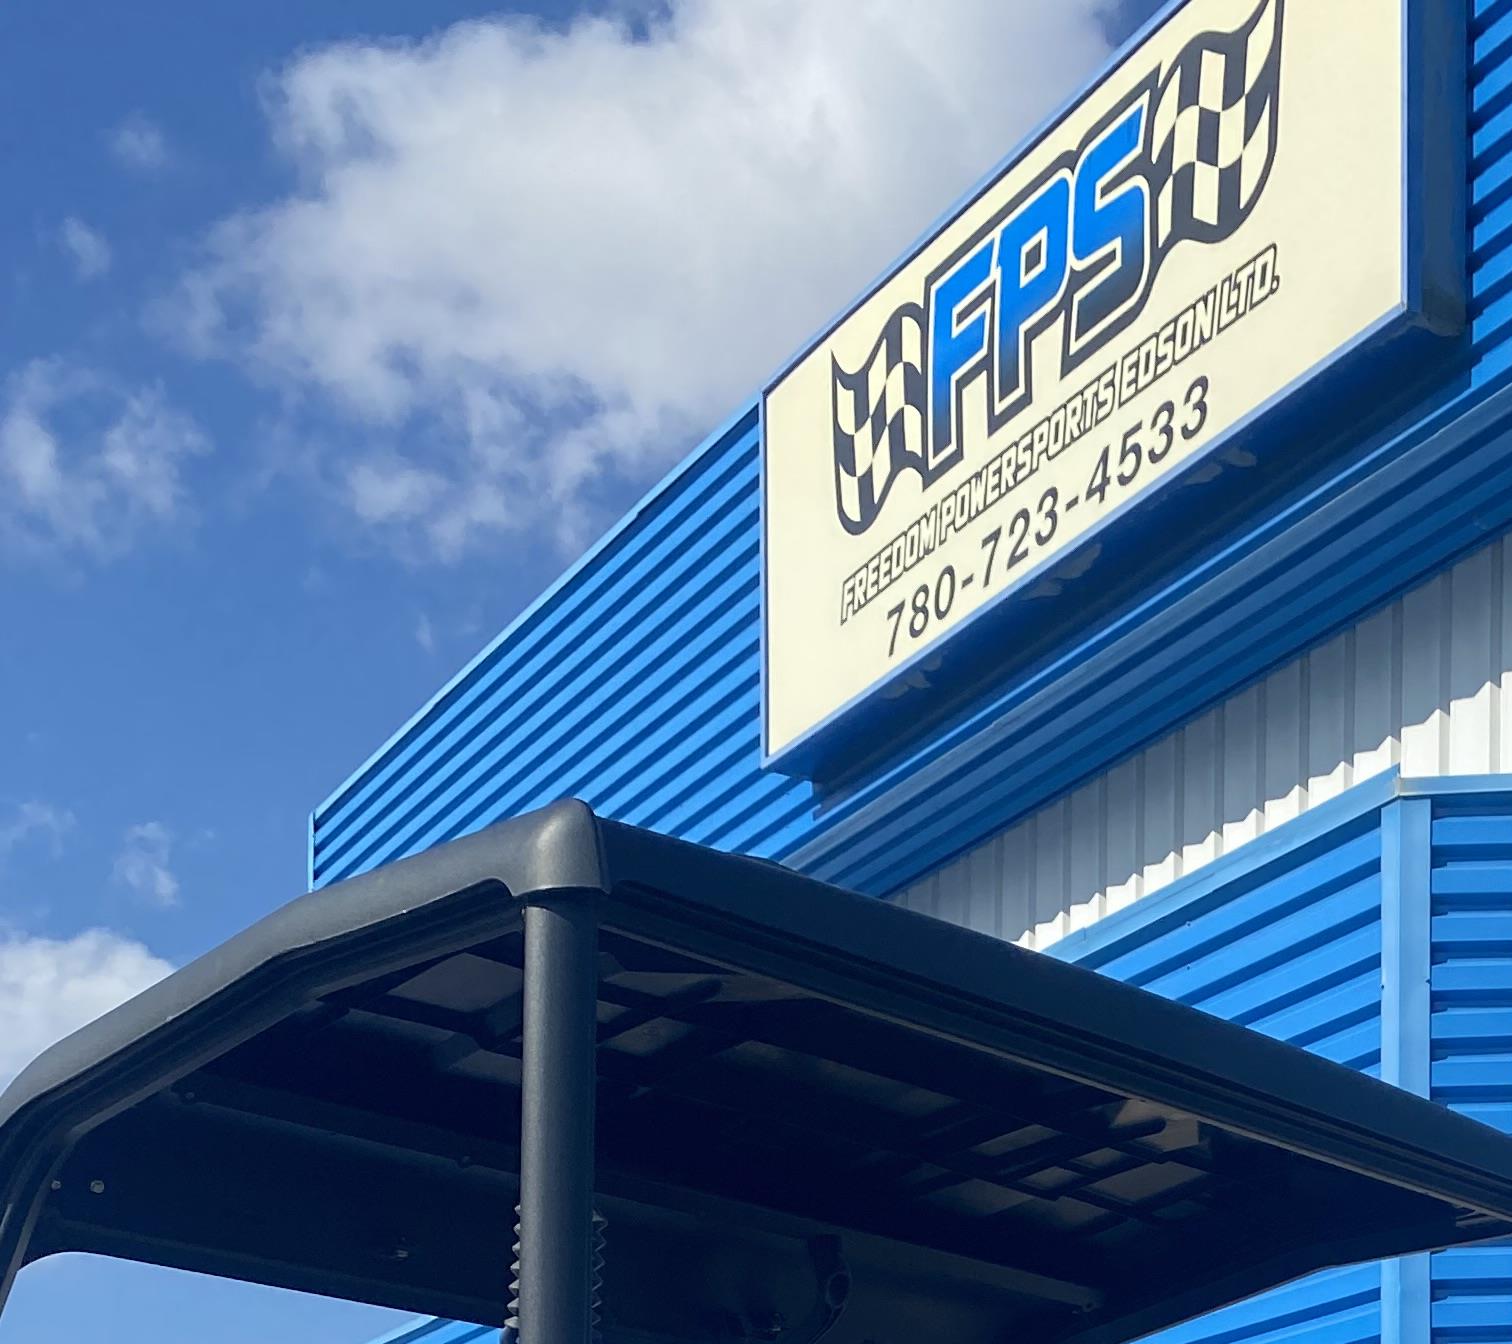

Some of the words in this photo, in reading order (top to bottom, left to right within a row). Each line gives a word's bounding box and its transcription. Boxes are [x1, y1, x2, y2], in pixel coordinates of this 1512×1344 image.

[840, 512, 939, 626] FREEDOM
[938, 362, 1117, 546] POWERSPORTS
[1117, 288, 1219, 408] EDSON
[1217, 242, 1281, 337] LTD.
[924, 86, 1156, 472] FPS
[885, 375, 1210, 658] 780-723-4533
